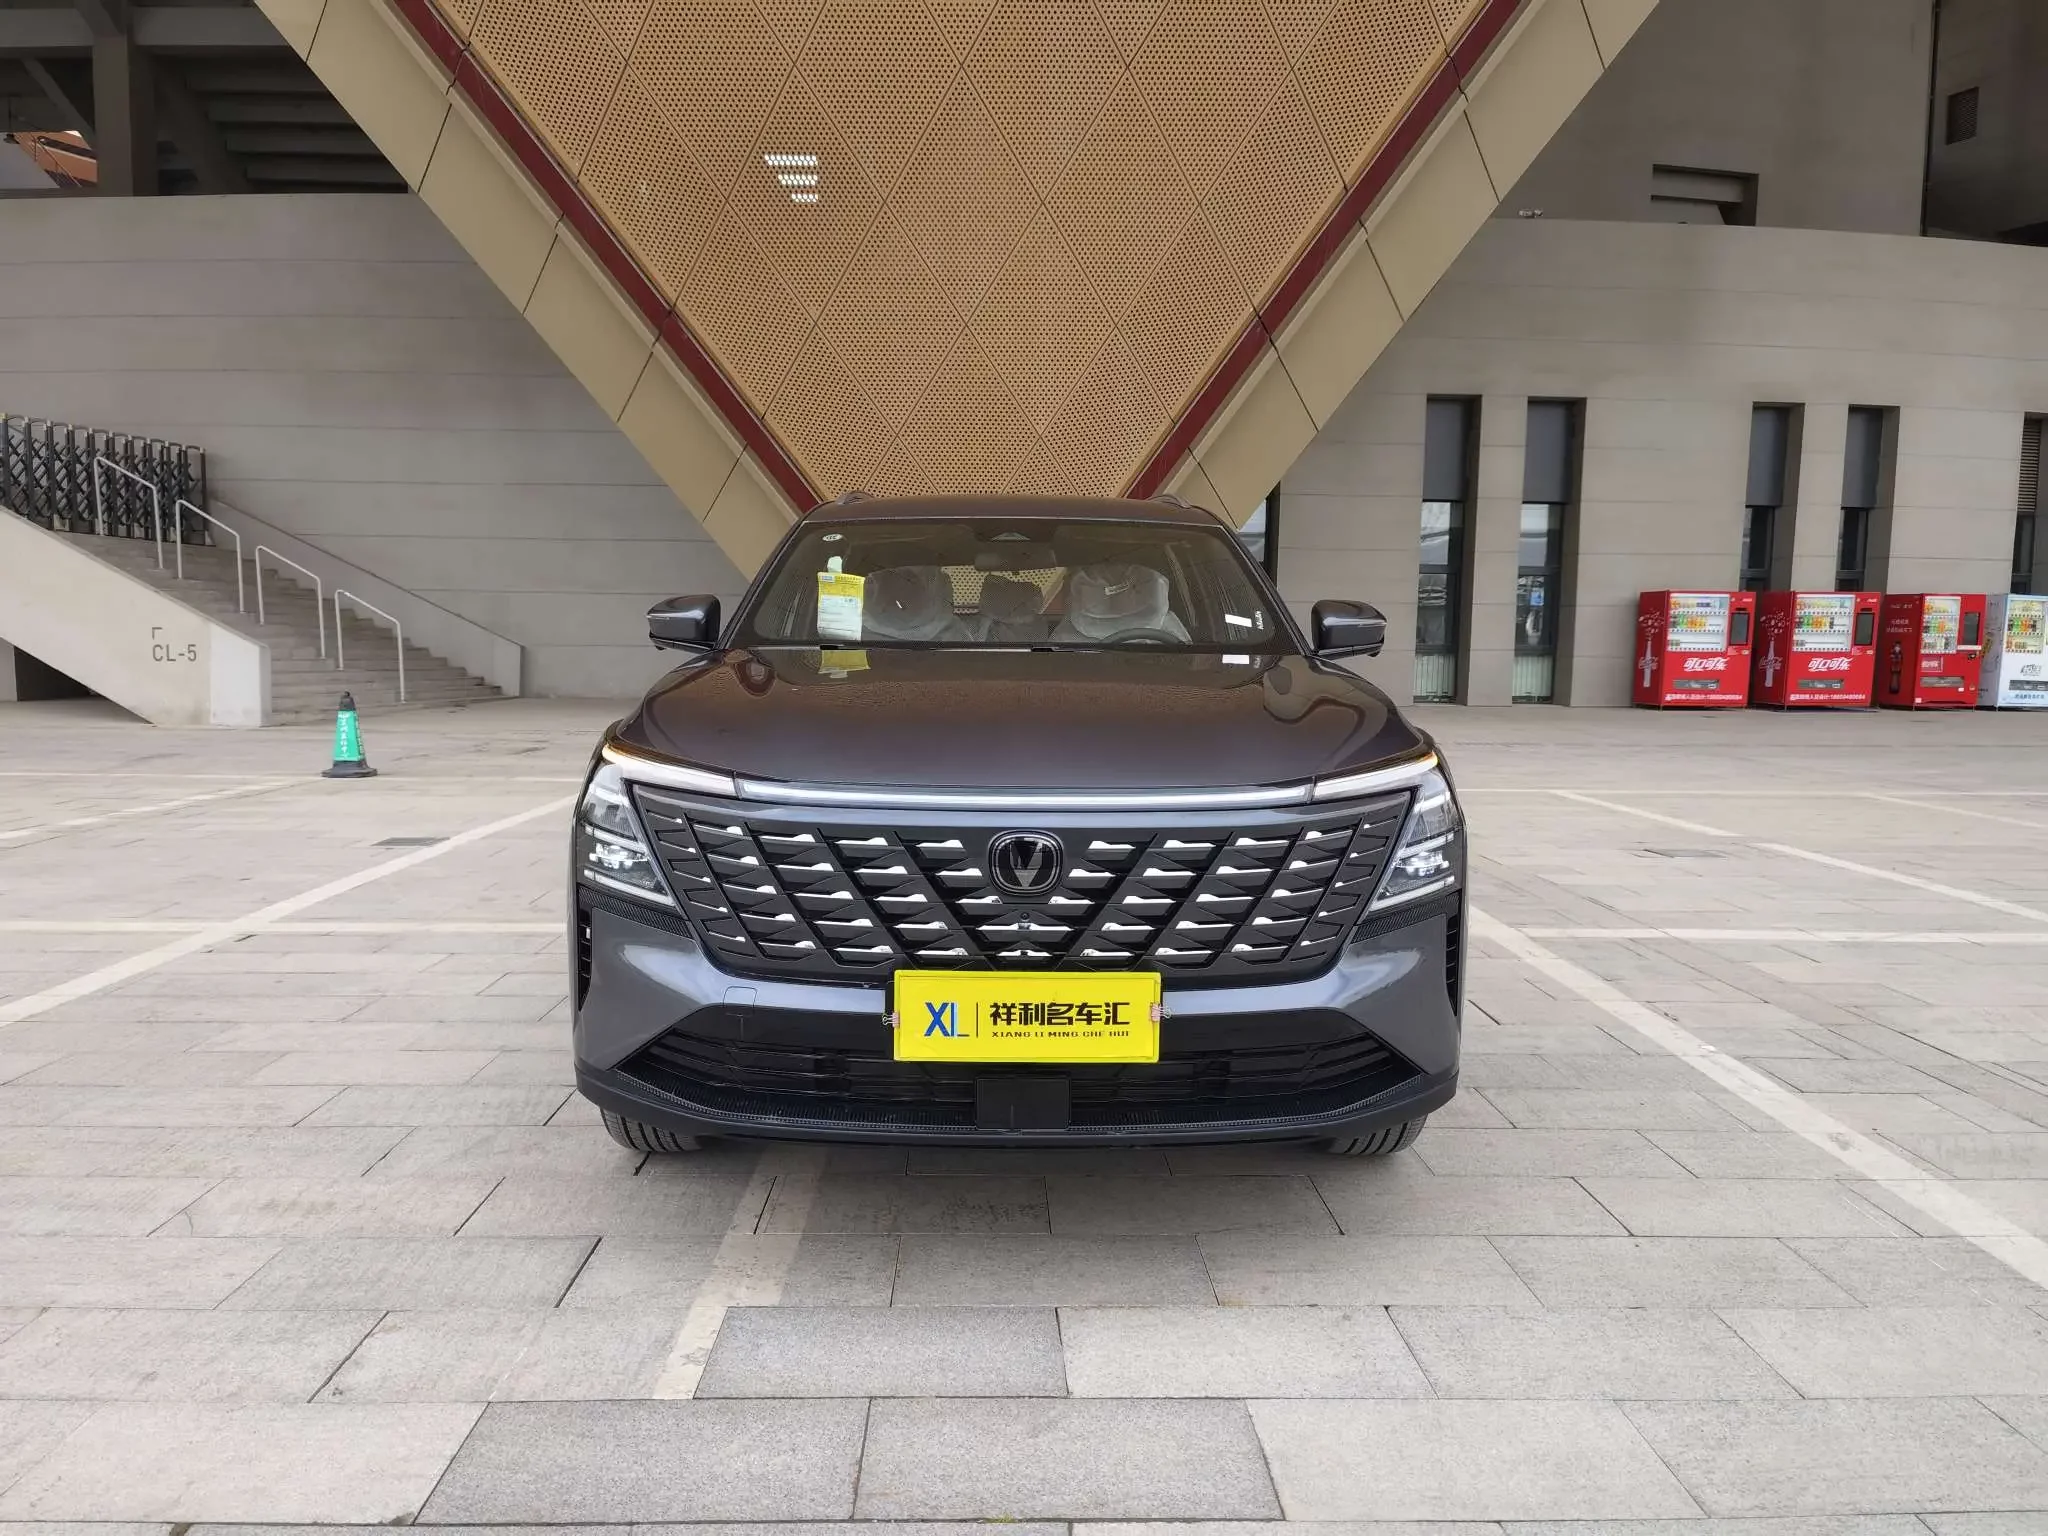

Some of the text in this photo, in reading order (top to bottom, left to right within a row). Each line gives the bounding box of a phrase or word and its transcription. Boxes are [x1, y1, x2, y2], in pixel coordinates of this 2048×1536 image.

[152, 644, 197, 662] CL-5
[1683, 656, 1729, 672] 可口可乐
[1808, 656, 1853, 672] 可口可乐
[923, 1002, 970, 1037] XL
[989, 1001, 1130, 1026] 祥利名车汇
